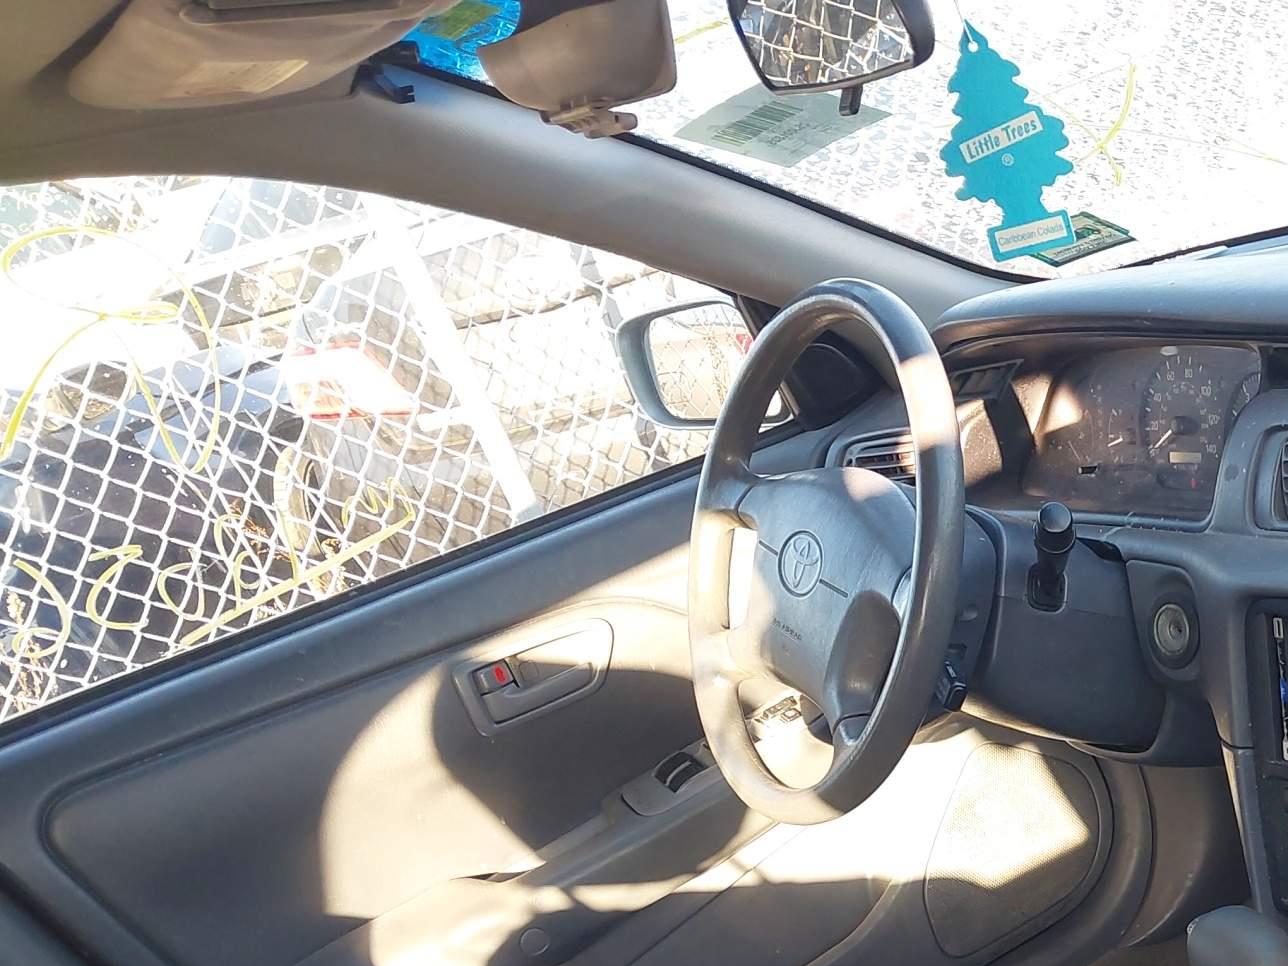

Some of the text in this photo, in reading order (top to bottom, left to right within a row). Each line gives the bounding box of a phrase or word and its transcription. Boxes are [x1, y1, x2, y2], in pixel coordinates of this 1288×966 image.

[966, 119, 1038, 161] Little Trees
[999, 230, 1037, 247] Caribbean
